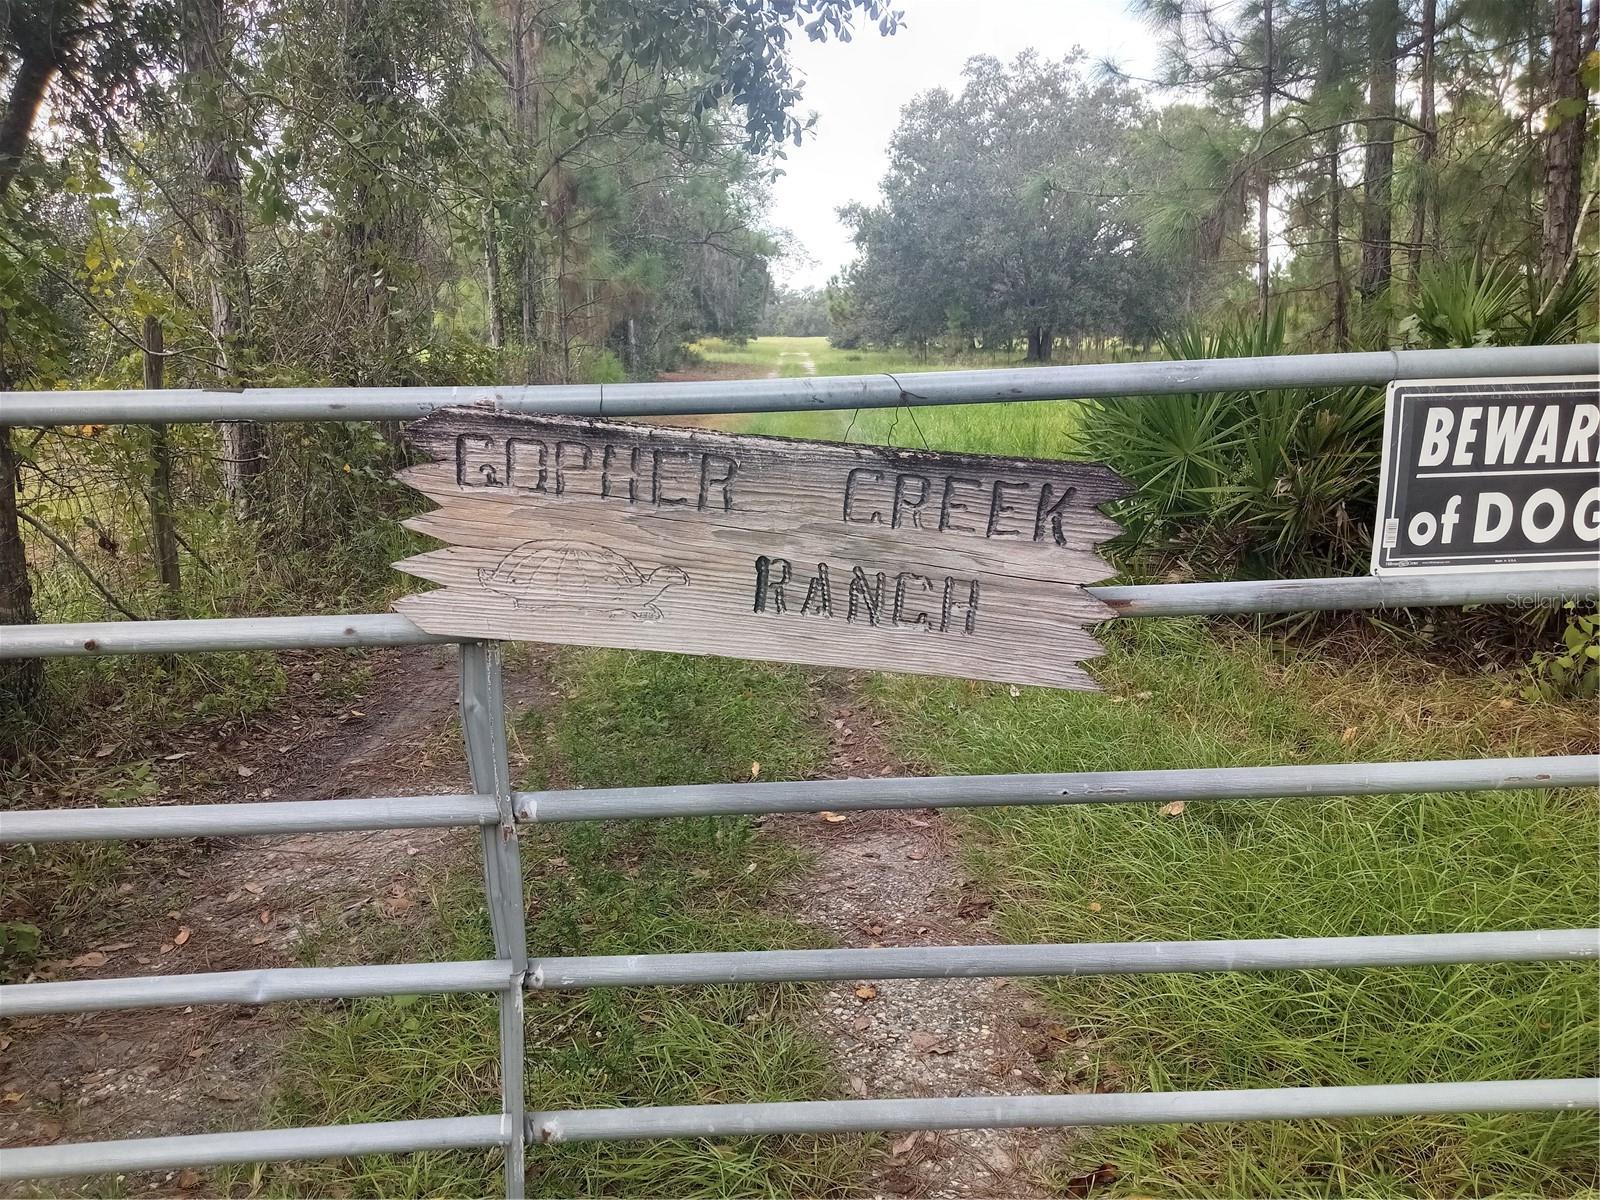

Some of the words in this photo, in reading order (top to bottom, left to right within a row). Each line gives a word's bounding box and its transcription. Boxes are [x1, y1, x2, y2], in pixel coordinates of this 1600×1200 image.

[1418, 404, 1600, 467] BEWAR
[455, 432, 741, 513] GOPHER
[843, 467, 1077, 546] CREEK
[1408, 494, 1462, 546] of
[754, 555, 980, 635] RANCH
